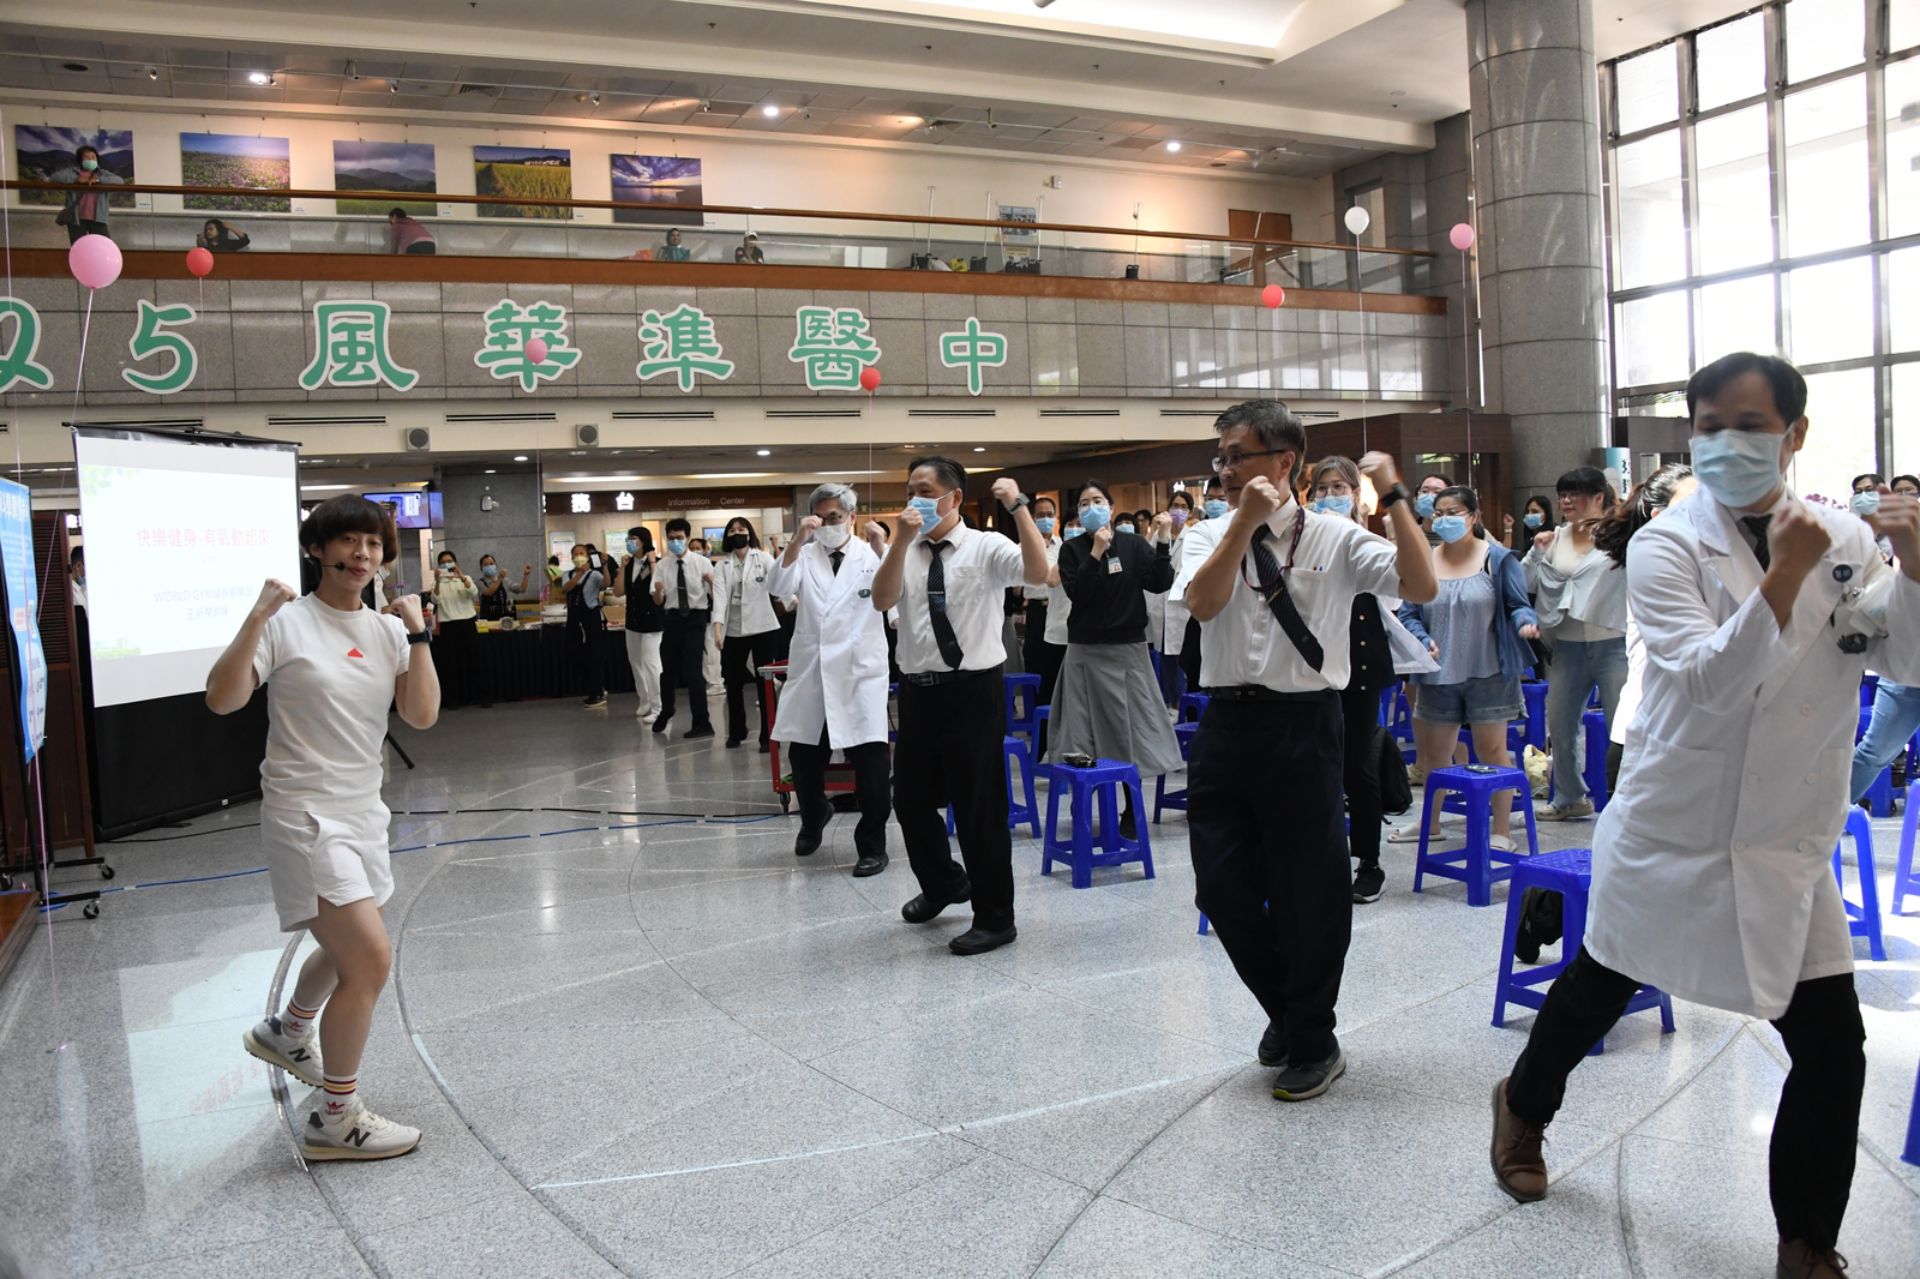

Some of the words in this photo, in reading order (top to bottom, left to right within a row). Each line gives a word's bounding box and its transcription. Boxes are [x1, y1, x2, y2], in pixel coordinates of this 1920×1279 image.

[668, 498, 710, 506] Information
[720, 497, 745, 505] Center
[153, 590, 191, 603] WORLD
[288, 1047, 311, 1062] N
[343, 1126, 371, 1147] N
